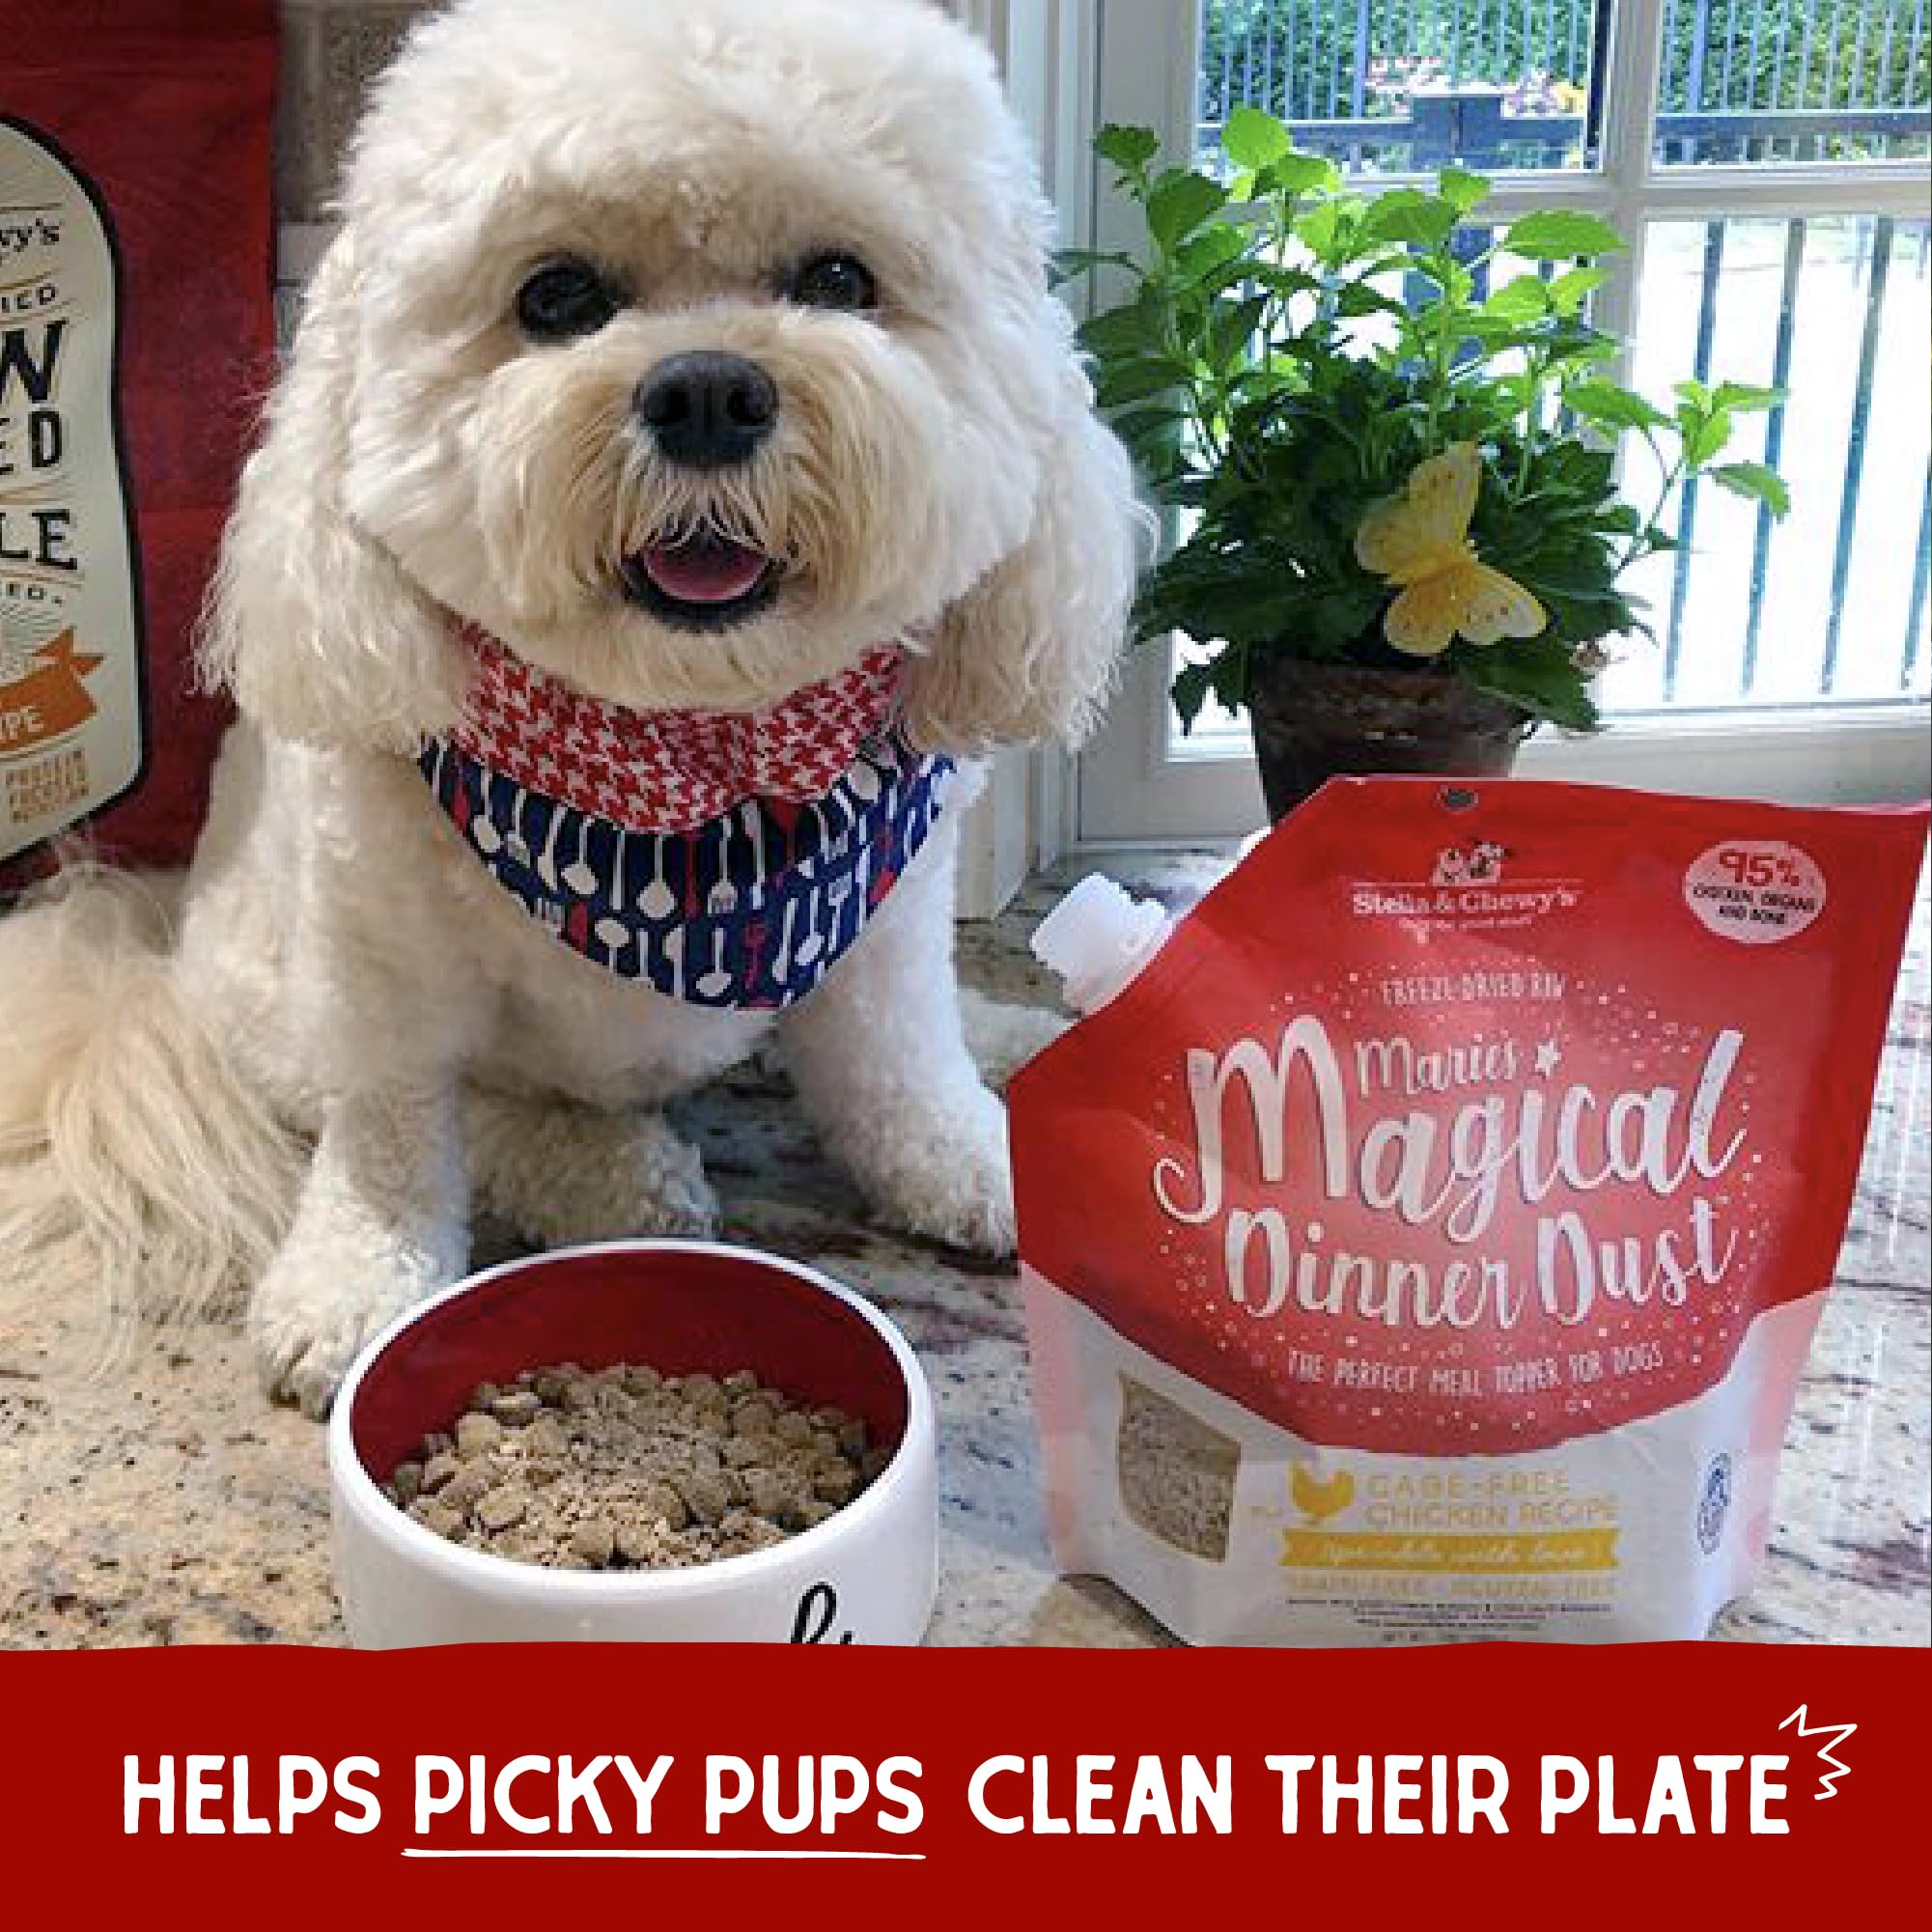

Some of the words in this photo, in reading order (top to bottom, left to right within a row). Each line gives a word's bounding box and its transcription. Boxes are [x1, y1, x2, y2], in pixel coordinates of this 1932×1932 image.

[1719, 849, 1801, 887] 95%
[1353, 890, 1430, 915] Stella
[1433, 891, 1455, 912] &
[1458, 887, 1578, 913] Chewy's
[1153, 1014, 1749, 1244] Magical
[1223, 1206, 1526, 1330] Dinner
[1536, 1193, 1738, 1326] Dust
[1287, 1349, 1327, 1382] THE
[1332, 1358, 1417, 1393] PERFECT
[1428, 1366, 1483, 1395] MEAL
[1494, 1358, 1561, 1392] TOPPER
[1567, 1351, 1603, 1383] FOR
[1611, 1340, 1664, 1373] DOGS
[1364, 1505, 1508, 1528] CHICKEN
